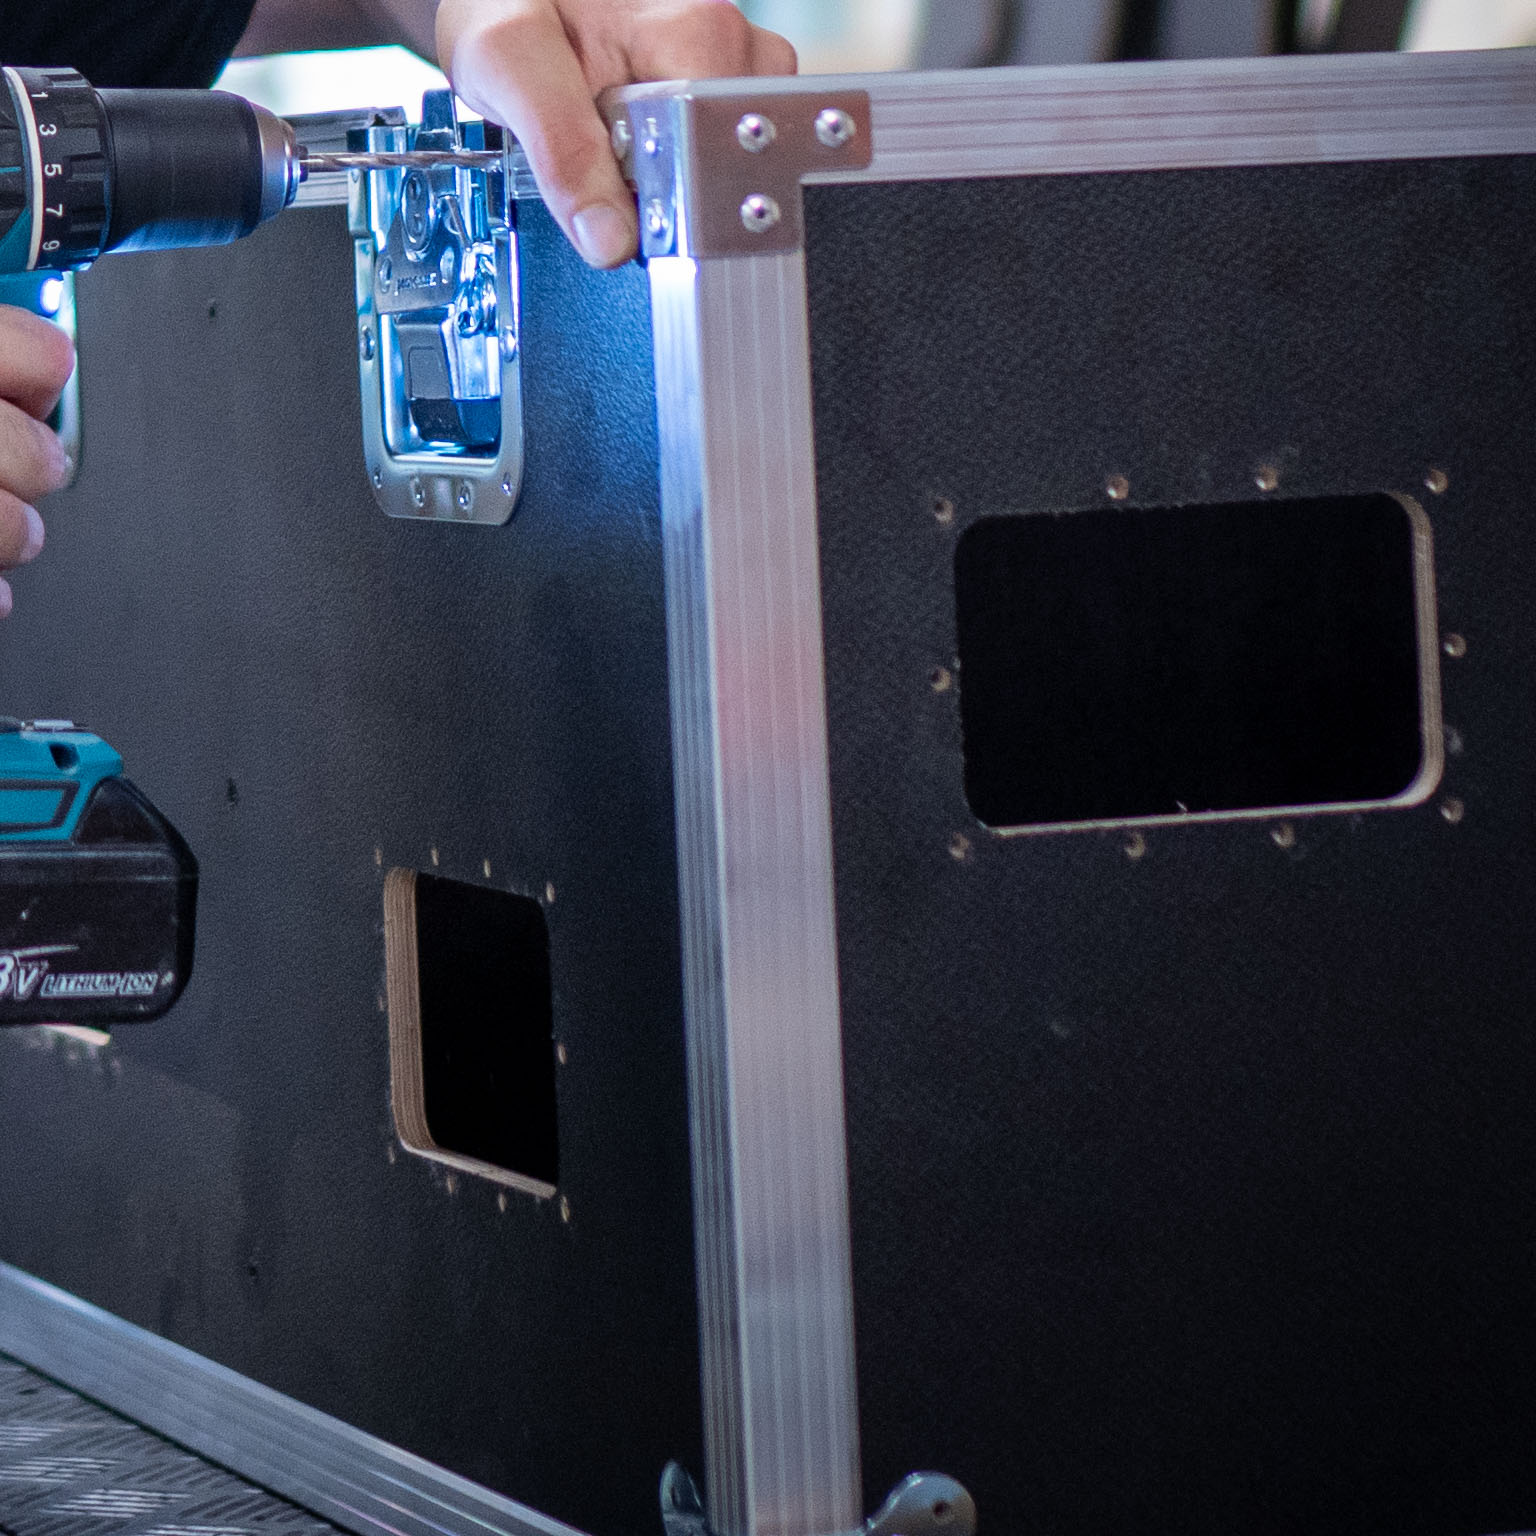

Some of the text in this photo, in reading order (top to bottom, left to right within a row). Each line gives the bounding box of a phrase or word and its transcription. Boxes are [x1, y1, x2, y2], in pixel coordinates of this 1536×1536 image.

[39, 124, 57, 136] 3
[44, 163, 62, 176] 5
[45, 203, 63, 216] 7
[42, 240, 60, 251] 9
